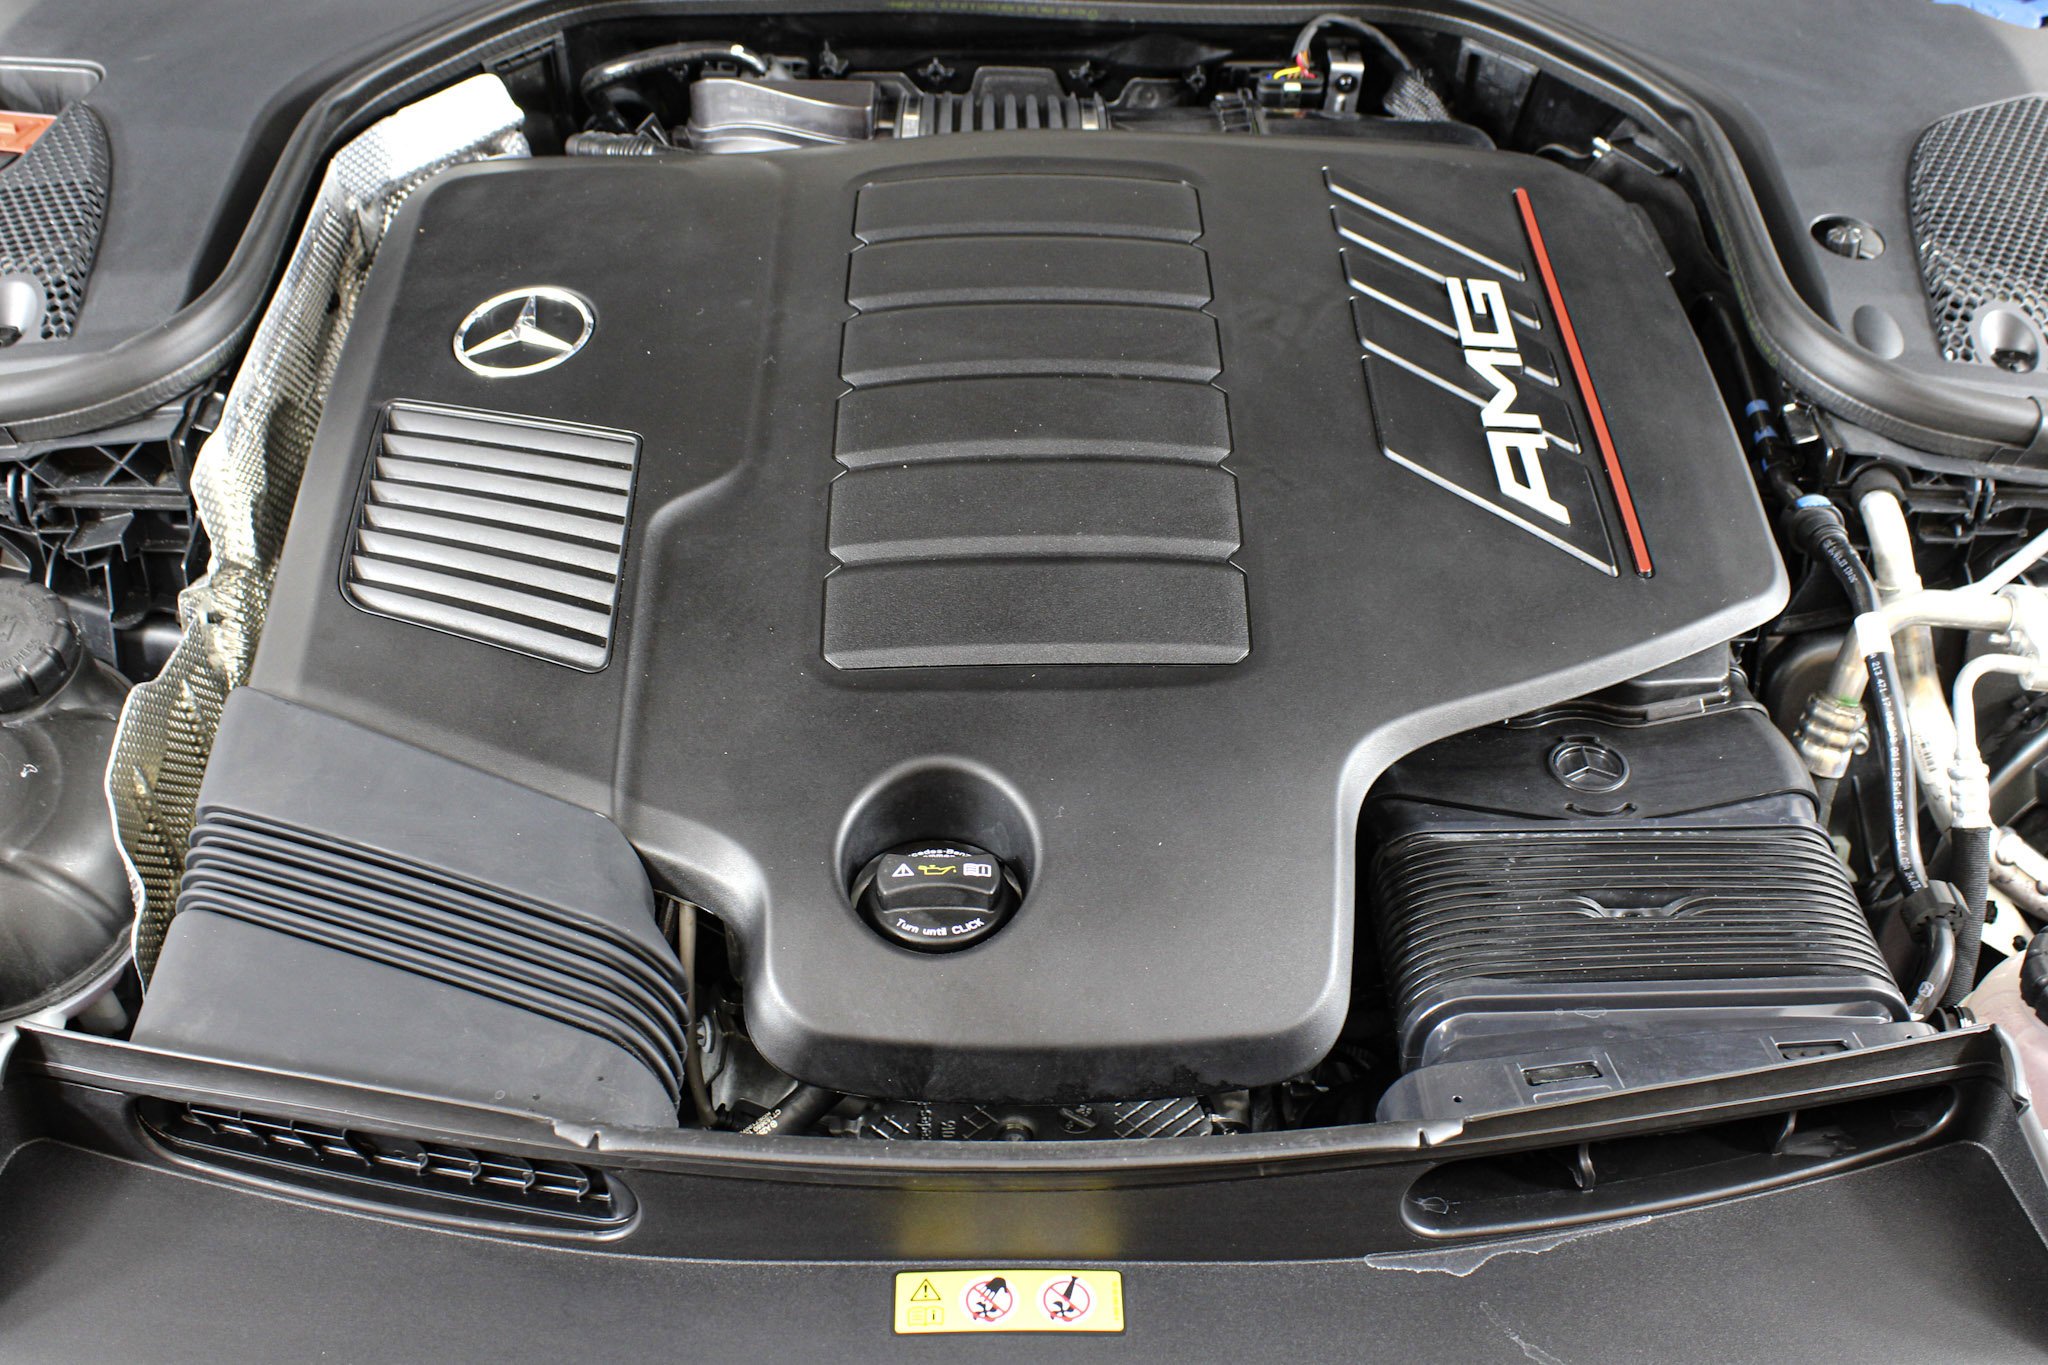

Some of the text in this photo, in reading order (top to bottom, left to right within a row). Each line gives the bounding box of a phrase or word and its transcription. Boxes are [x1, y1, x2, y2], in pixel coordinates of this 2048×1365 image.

[1446, 277, 1571, 525] AMG
[896, 917, 985, 936] Turn until CLICK
